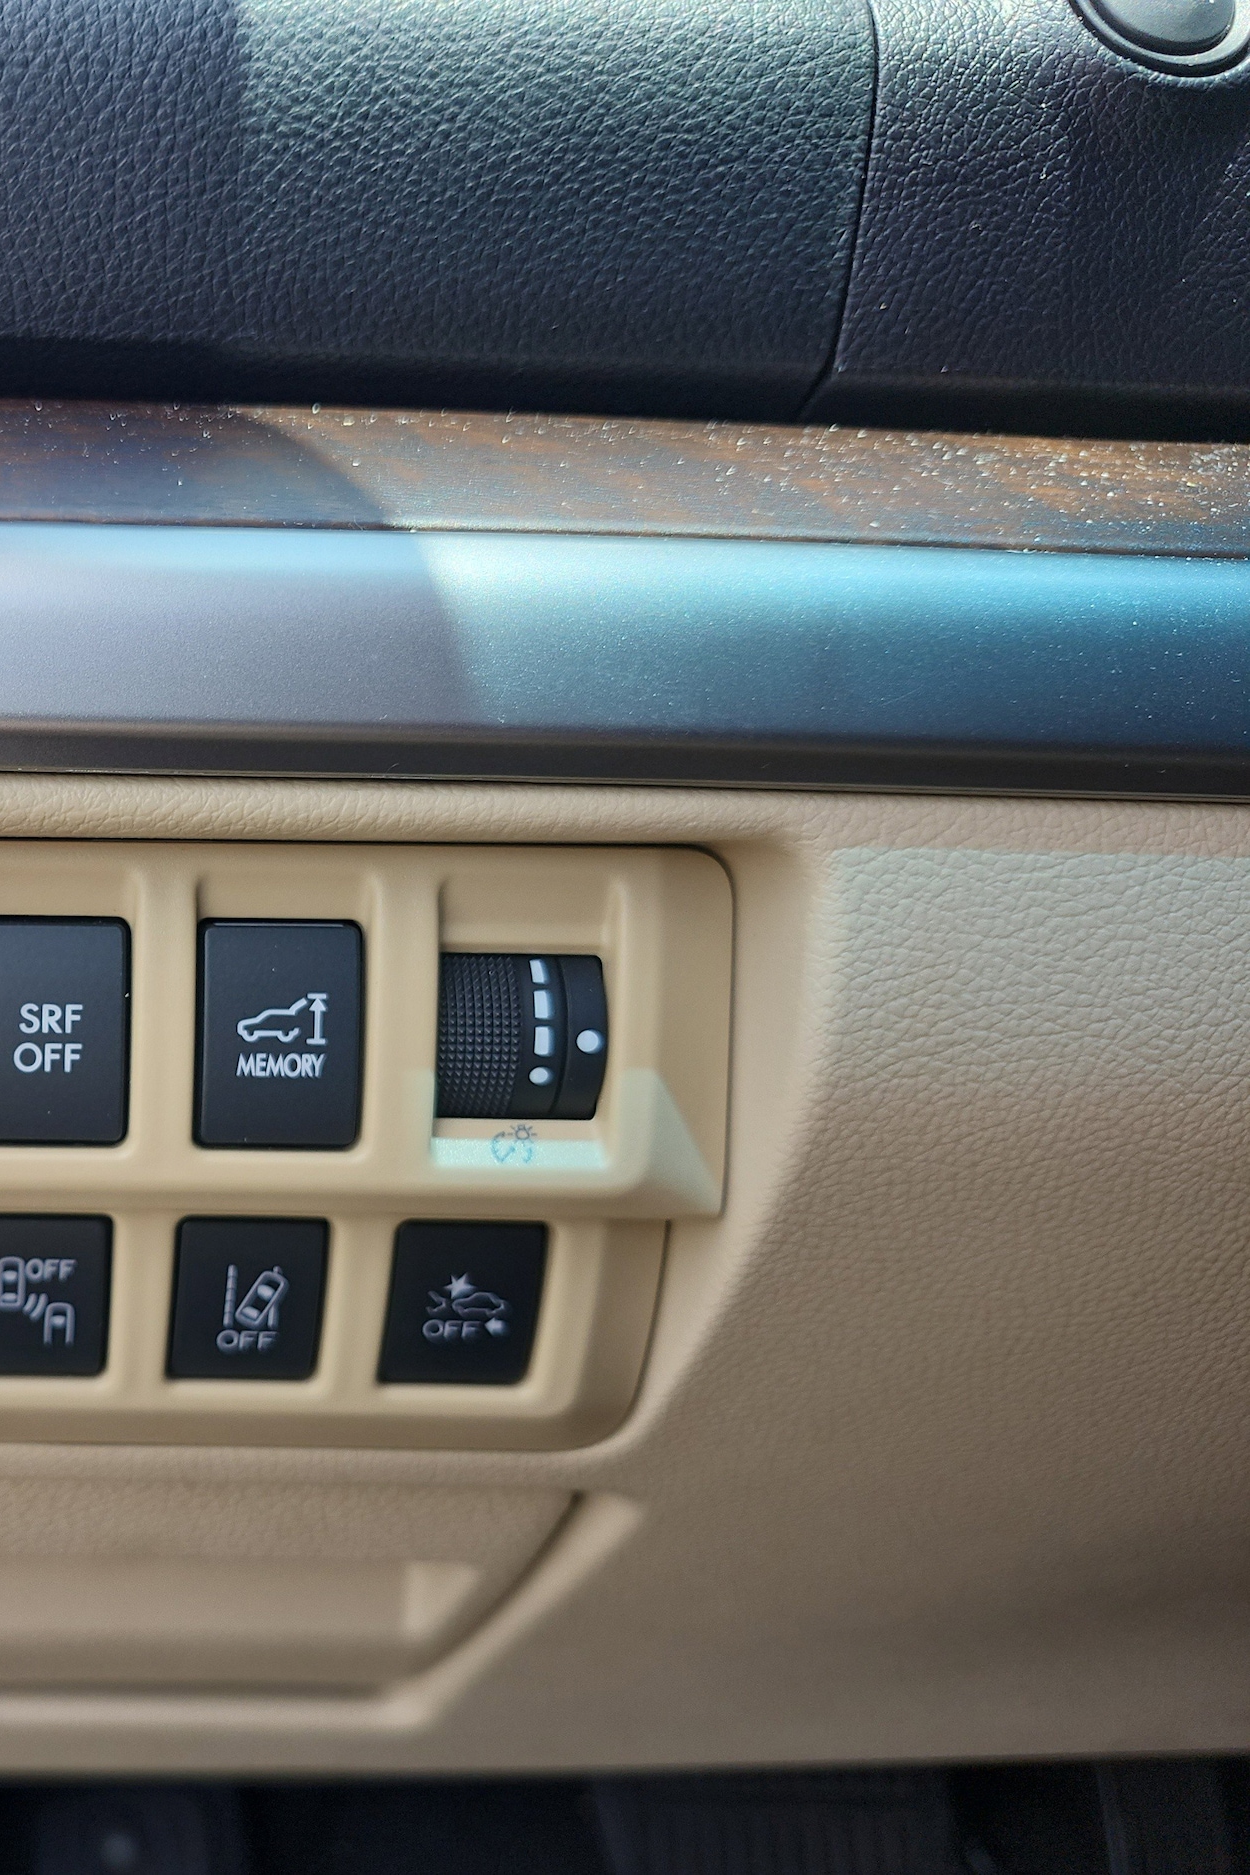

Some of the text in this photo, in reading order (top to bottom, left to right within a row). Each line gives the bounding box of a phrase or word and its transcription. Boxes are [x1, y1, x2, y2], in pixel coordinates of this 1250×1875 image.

[19, 1003, 83, 1034] SRF
[13, 1042, 83, 1073] OFF
[236, 1053, 325, 1079] MEMORY
[25, 1257, 77, 1282] OFF
[216, 1329, 279, 1354] OFF
[421, 1319, 482, 1344] OFF
